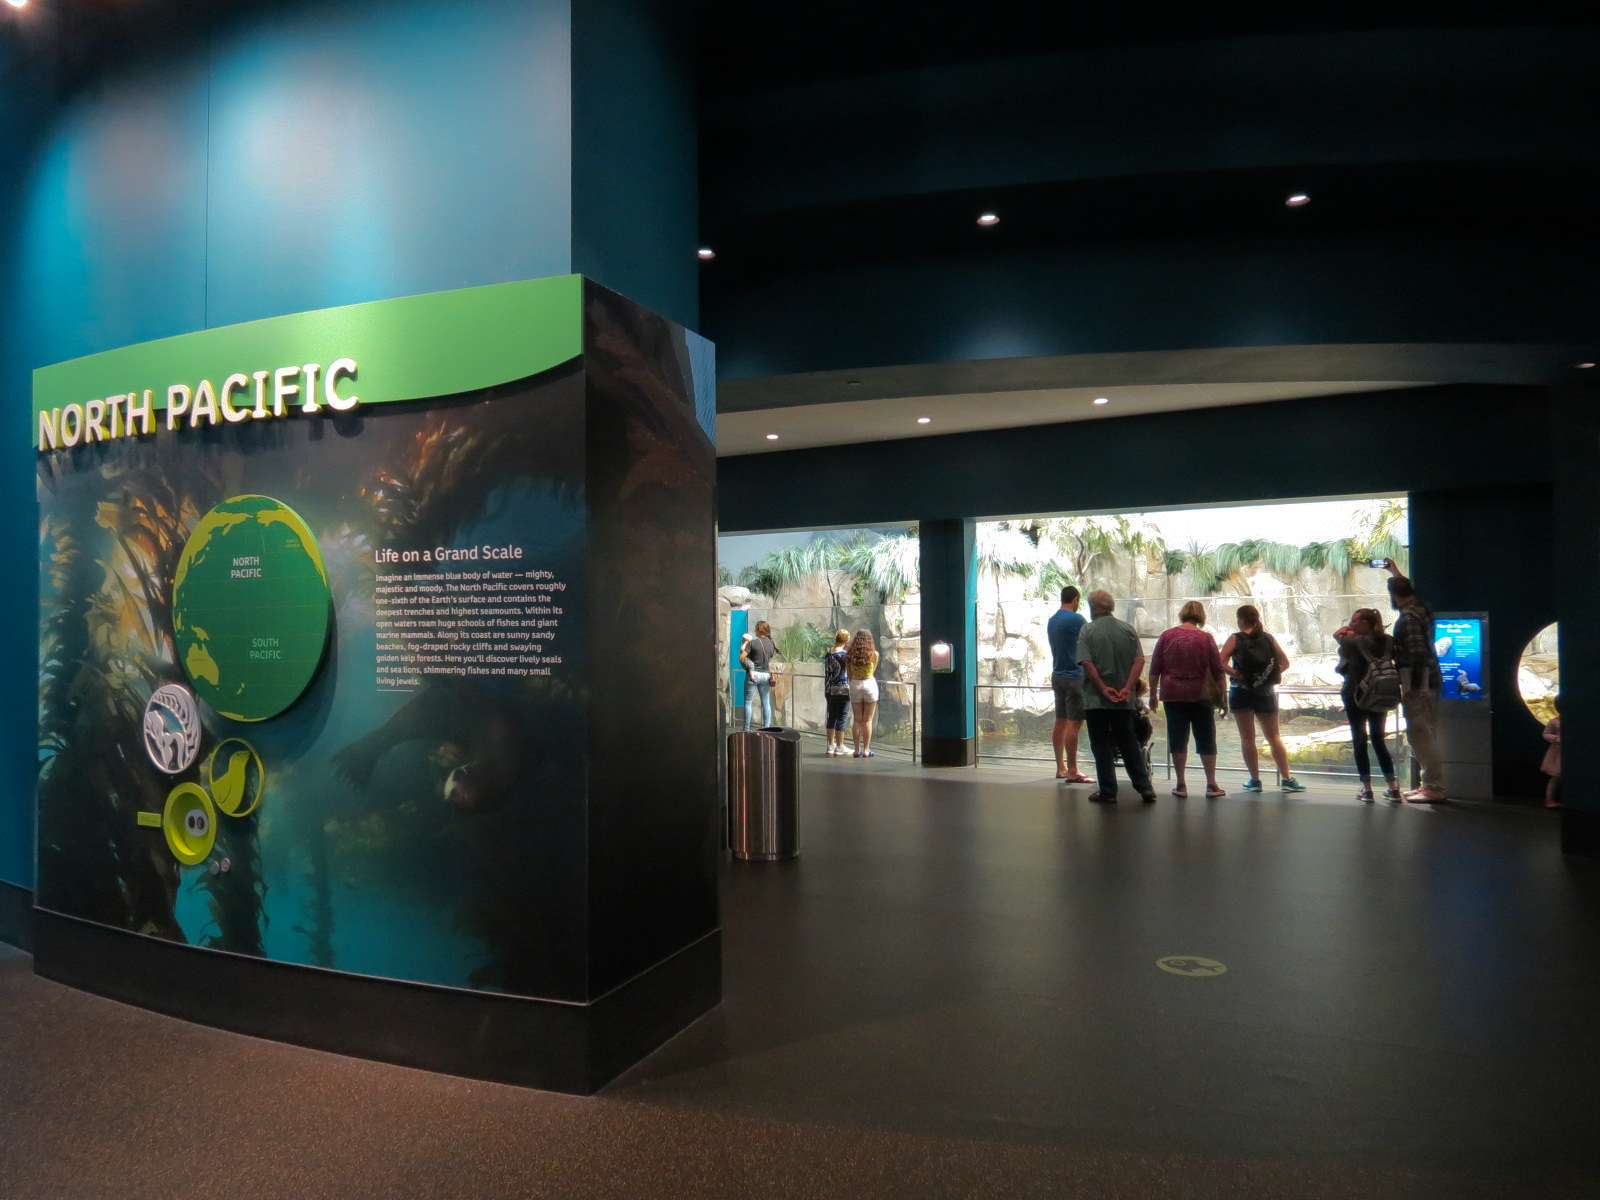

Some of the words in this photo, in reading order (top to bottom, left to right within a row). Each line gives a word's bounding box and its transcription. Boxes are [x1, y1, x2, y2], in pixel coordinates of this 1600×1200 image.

[38, 389, 154, 451] NORTH
[167, 358, 359, 431] PACIFIC
[375, 548, 399, 563] Life
[402, 550, 419, 562] on
[423, 550, 432, 562] a
[434, 545, 478, 561] Grand
[482, 544, 523, 559] Scale
[232, 556, 260, 567] NORTH
[230, 568, 262, 579] PACIFIC
[376, 574, 402, 583] Imagine
[446, 572, 461, 580] blue
[463, 572, 480, 581] body
[482, 571, 490, 579] of
[525, 570, 555, 579] mighty,
[376, 585, 403, 594] majestic
[420, 585, 444, 593] moody.
[446, 584, 458, 592] The
[482, 583, 507, 591] Pacific
[536, 582, 566, 592] roughly
[409, 596, 418, 604] of
[419, 596, 430, 604] the
[459, 595, 485, 603] surface
[488, 595, 502, 603] and
[503, 594, 537, 603] contains
[538, 594, 551, 603] the
[376, 609, 402, 617] deepest
[451, 607, 478, 616] highest
[480, 607, 523, 615] seamounts.
[525, 606, 551, 614] Within
[553, 606, 563, 614] its
[376, 621, 392, 629] open
[438, 619, 455, 628] huge
[458, 619, 485, 627] schools
[487, 619, 495, 627] of
[497, 619, 519, 627] fishes
[521, 619, 535, 627] and
[538, 618, 558, 628] giant
[376, 631, 399, 639] marine
[401, 631, 436, 639] mammals.
[437, 631, 458, 640] Along
[506, 632, 530, 640] sunny
[532, 631, 555, 640] sandy
[252, 638, 279, 647] SOUTH
[376, 643, 406, 651] beaches,
[408, 643, 448, 652] fog-draped
[450, 643, 471, 652] rocky
[472, 643, 492, 651] cliffs
[493, 643, 508, 651] and
[510, 643, 542, 652] swaying
[250, 650, 282, 660] PACIFIC
[376, 655, 399, 663] golden
[400, 655, 415, 663] kelp
[416, 654, 444, 662] forests.
[486, 655, 518, 663] discover
[519, 655, 540, 664] lively
[541, 655, 562, 663] seals
[403, 666, 422, 674] lions,
[424, 666, 466, 675] shimmering
[467, 666, 490, 674] fishes
[491, 667, 506, 675] and
[507, 668, 528, 676] many
[529, 667, 551, 675] small
[376, 677, 396, 686] living
[396, 677, 420, 686] jewels.
